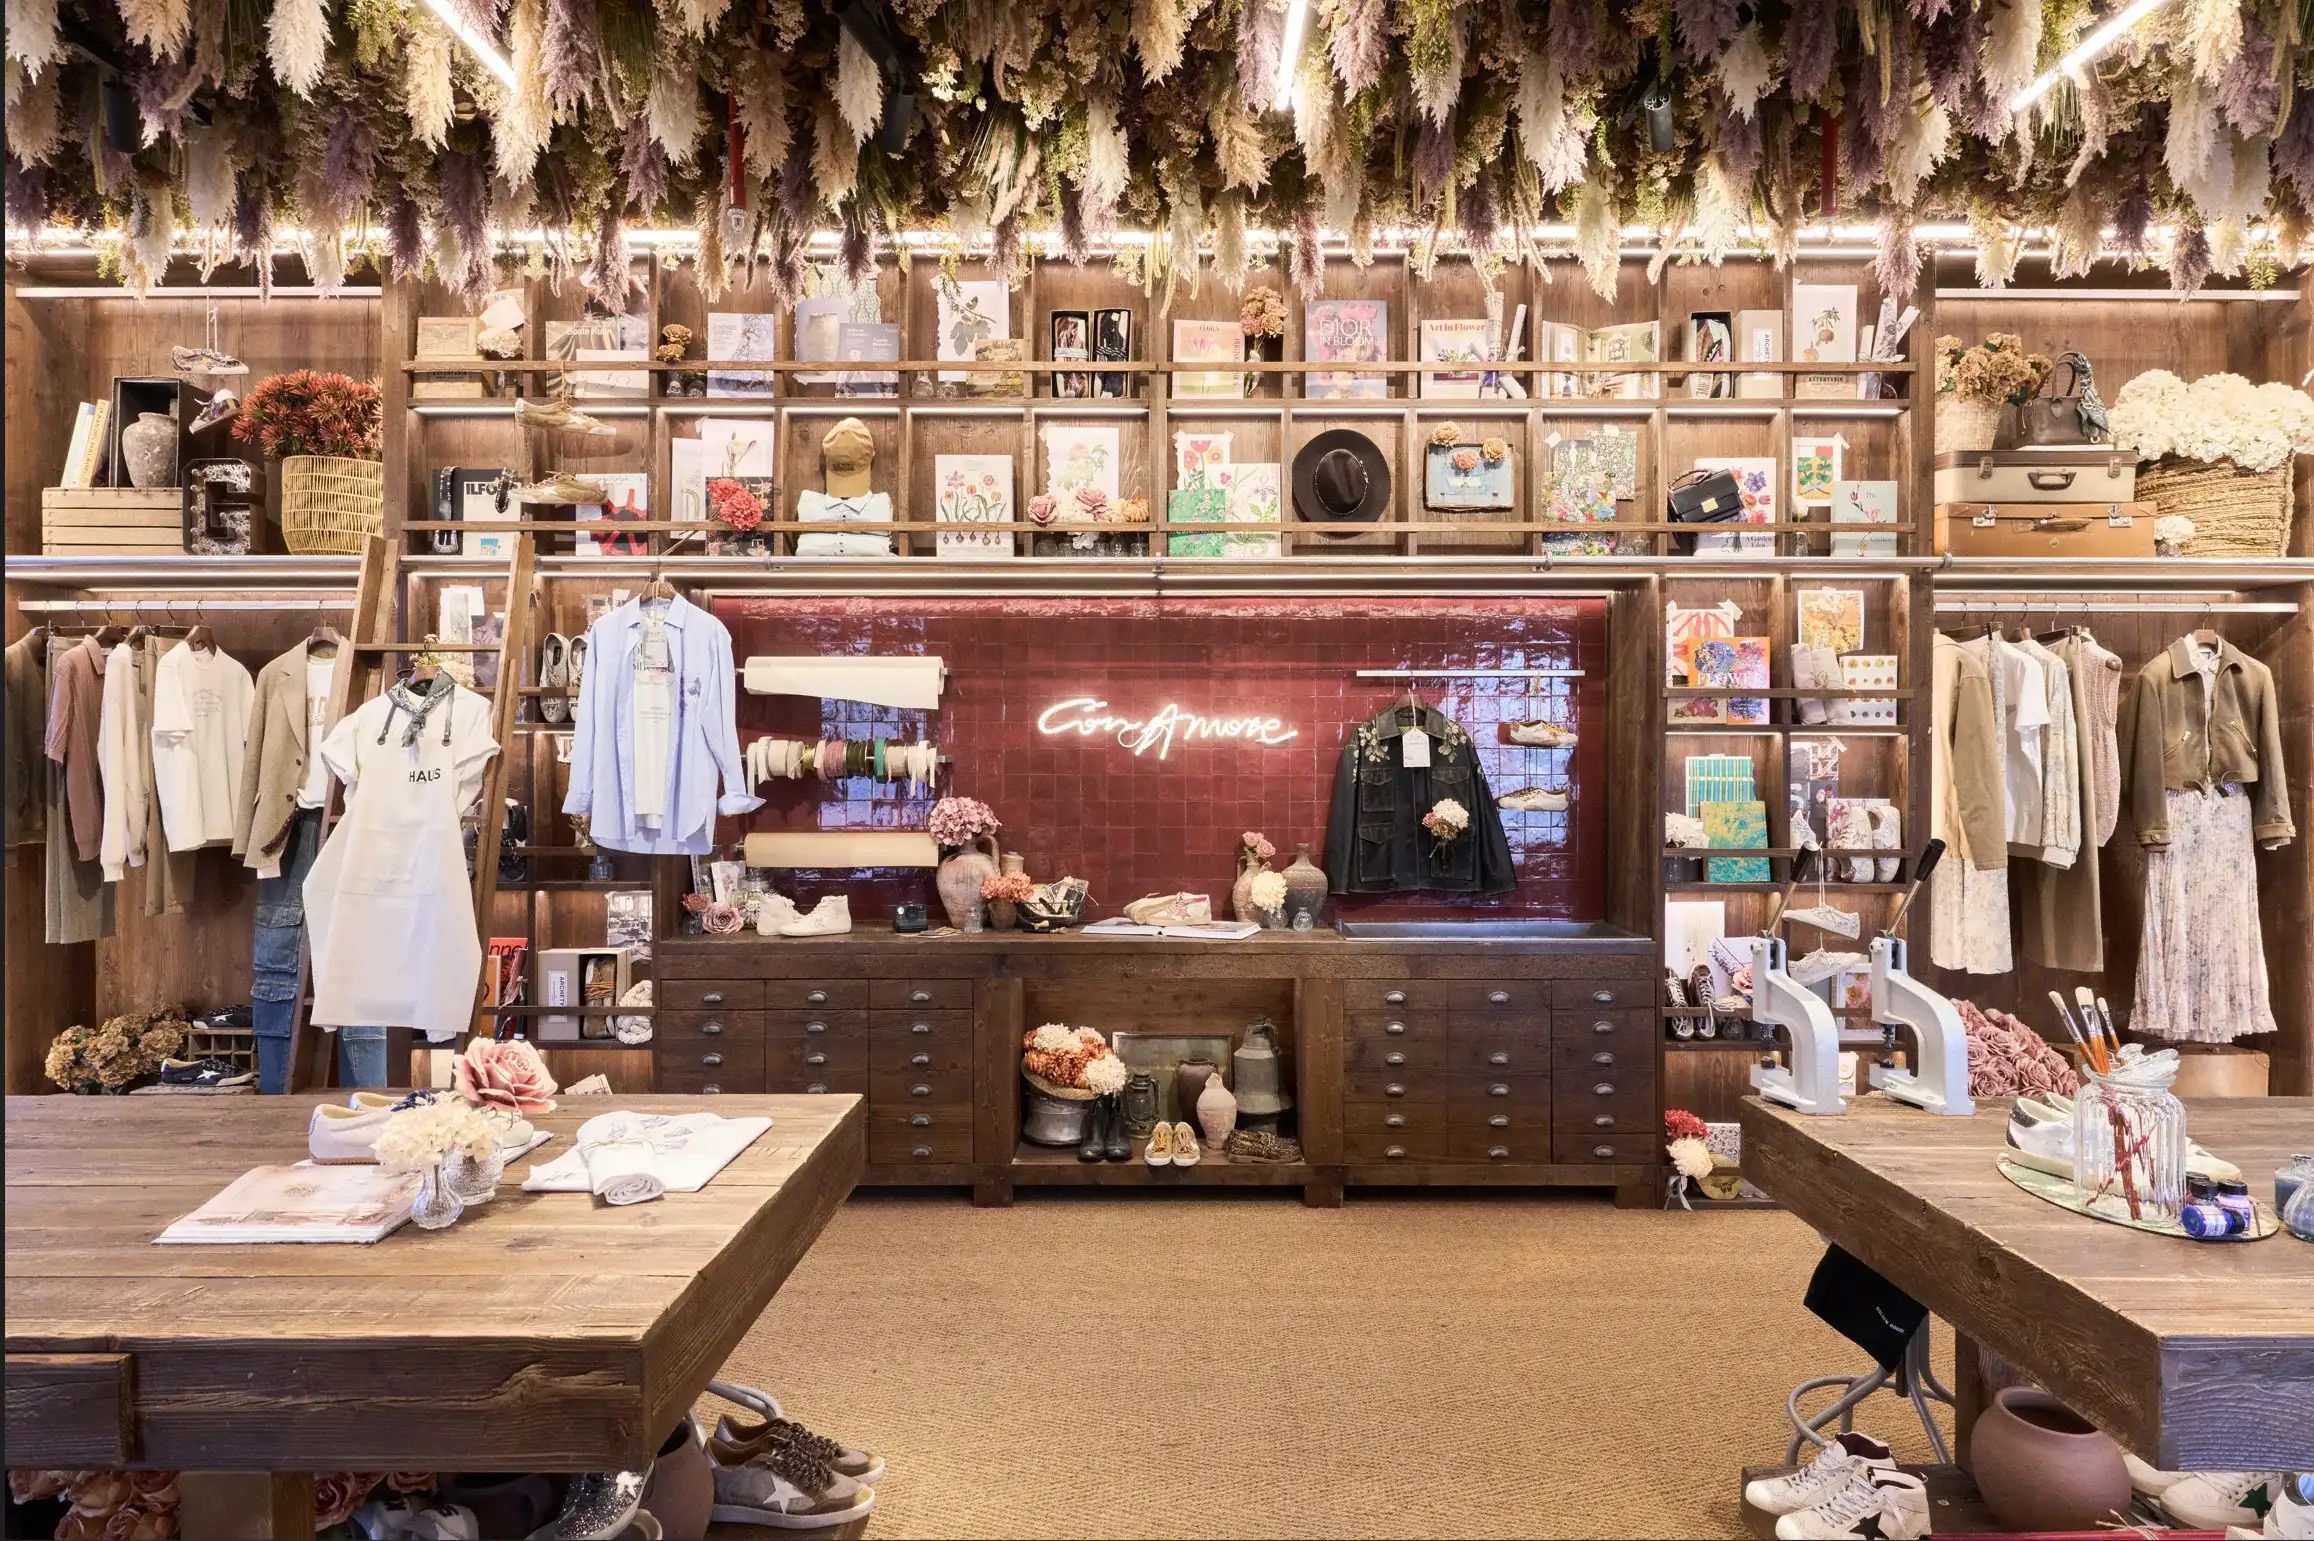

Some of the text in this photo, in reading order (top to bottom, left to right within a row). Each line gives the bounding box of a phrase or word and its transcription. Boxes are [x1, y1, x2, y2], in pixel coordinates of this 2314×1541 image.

[1199, 324, 1220, 332] FLORA
[1318, 318, 1372, 337] DIOR
[1428, 323, 1443, 333] Art
[1320, 337, 1374, 346] IN BLOOM
[466, 483, 511, 496] ILFO
[409, 767, 441, 783] HAUS
